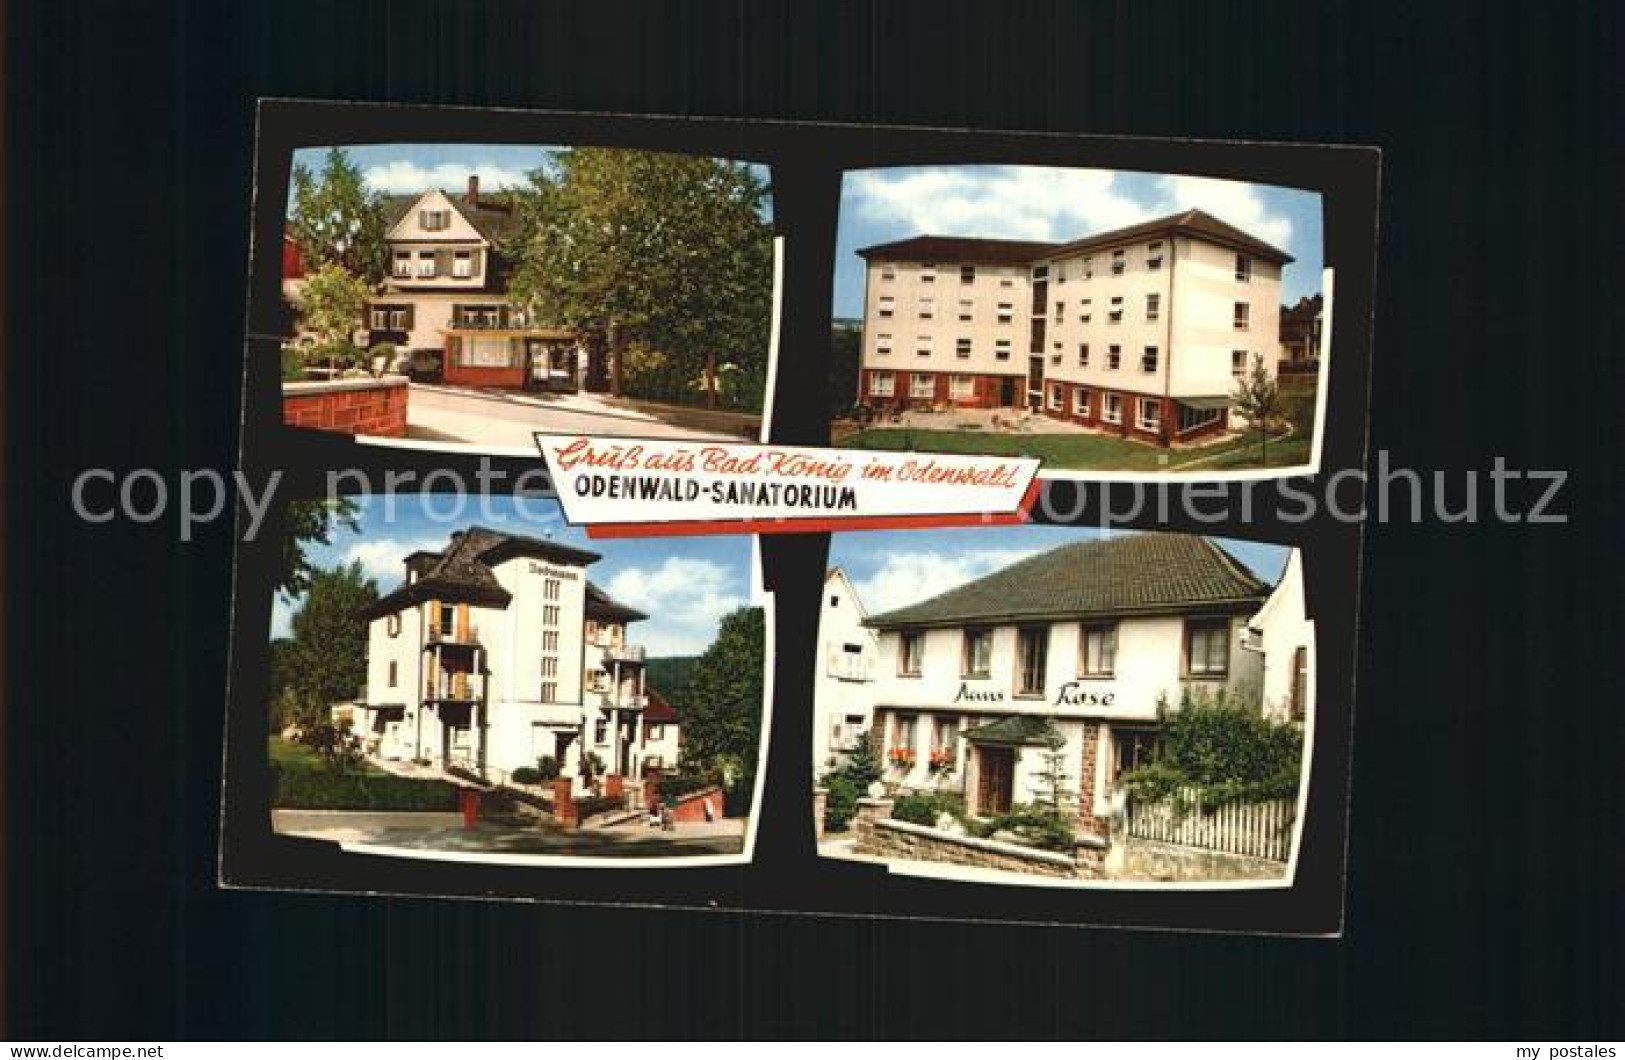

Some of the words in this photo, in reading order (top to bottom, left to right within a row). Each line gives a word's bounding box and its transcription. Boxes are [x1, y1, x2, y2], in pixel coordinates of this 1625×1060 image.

[643, 449, 694, 471] aus
[700, 447, 762, 474] Bad
[767, 452, 852, 483] König
[860, 456, 894, 481] im
[896, 459, 1020, 488] Odenwald
[574, 473, 858, 510] ODENWALD-SANATORIUM
